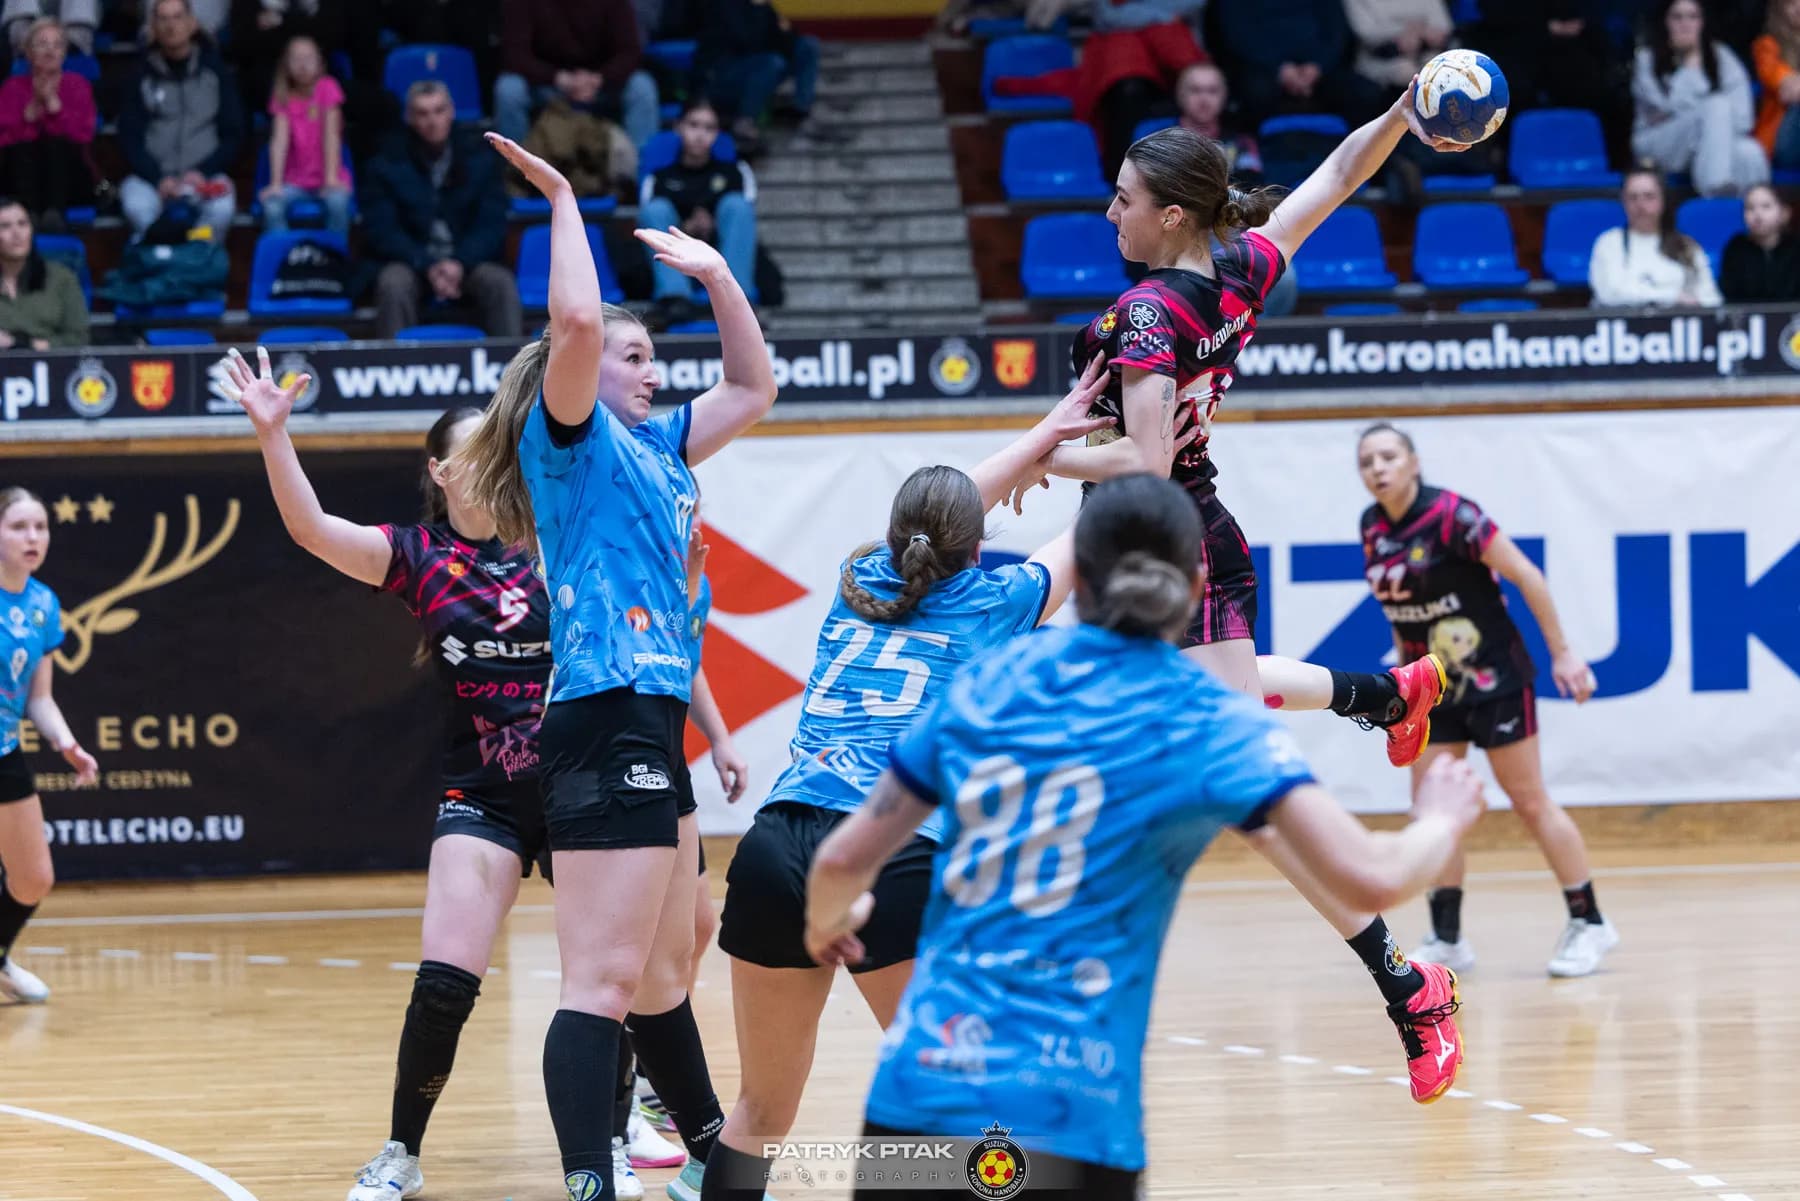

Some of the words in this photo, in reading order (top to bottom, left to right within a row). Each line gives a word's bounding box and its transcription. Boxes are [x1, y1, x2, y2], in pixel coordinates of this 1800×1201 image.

[1235, 314, 1765, 376] ww.koronahandball.pl
[805, 618, 950, 717] 25
[97, 713, 239, 751] ECHO
[43, 814, 245, 846] TELECHO.EU
[942, 754, 1106, 918] 88
